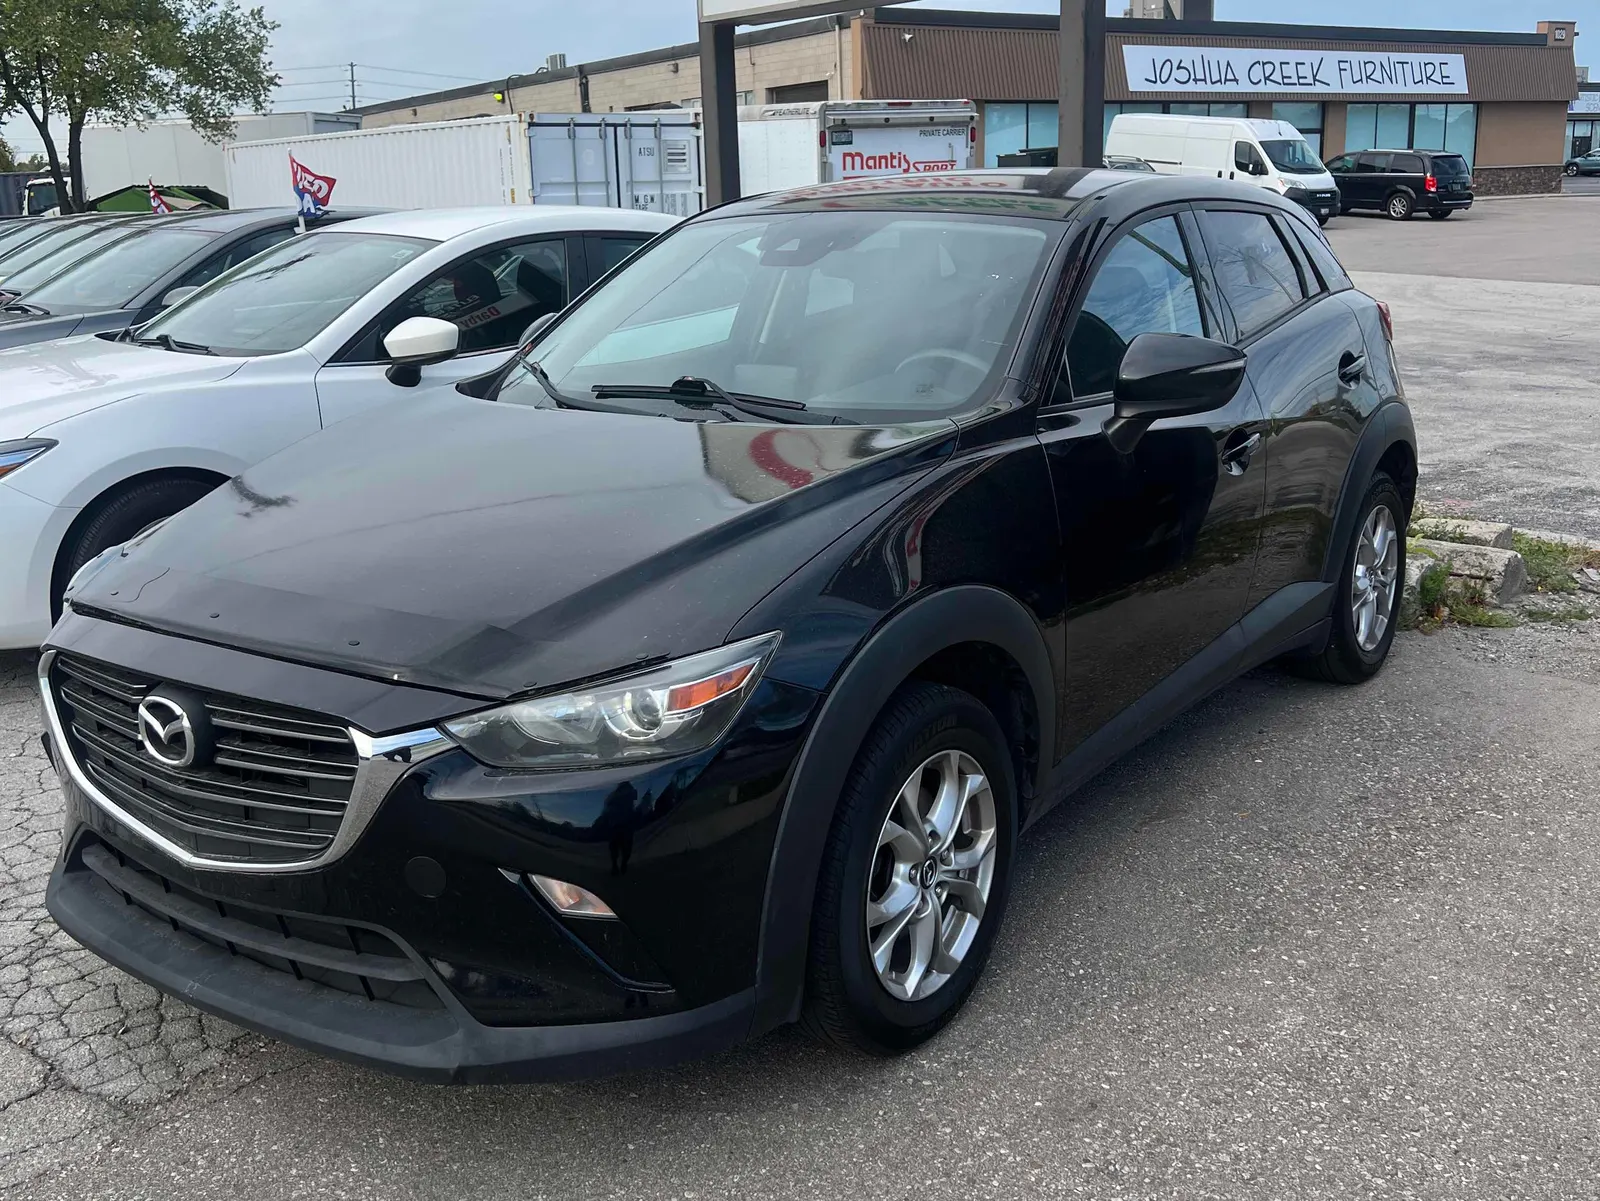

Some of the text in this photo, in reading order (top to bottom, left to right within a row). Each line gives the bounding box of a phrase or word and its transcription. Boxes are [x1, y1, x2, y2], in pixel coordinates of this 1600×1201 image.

[1144, 54, 1456, 88] JOSHUA CREEK FURNITURE
[919, 127, 966, 138] PRIVATE CARRIER
